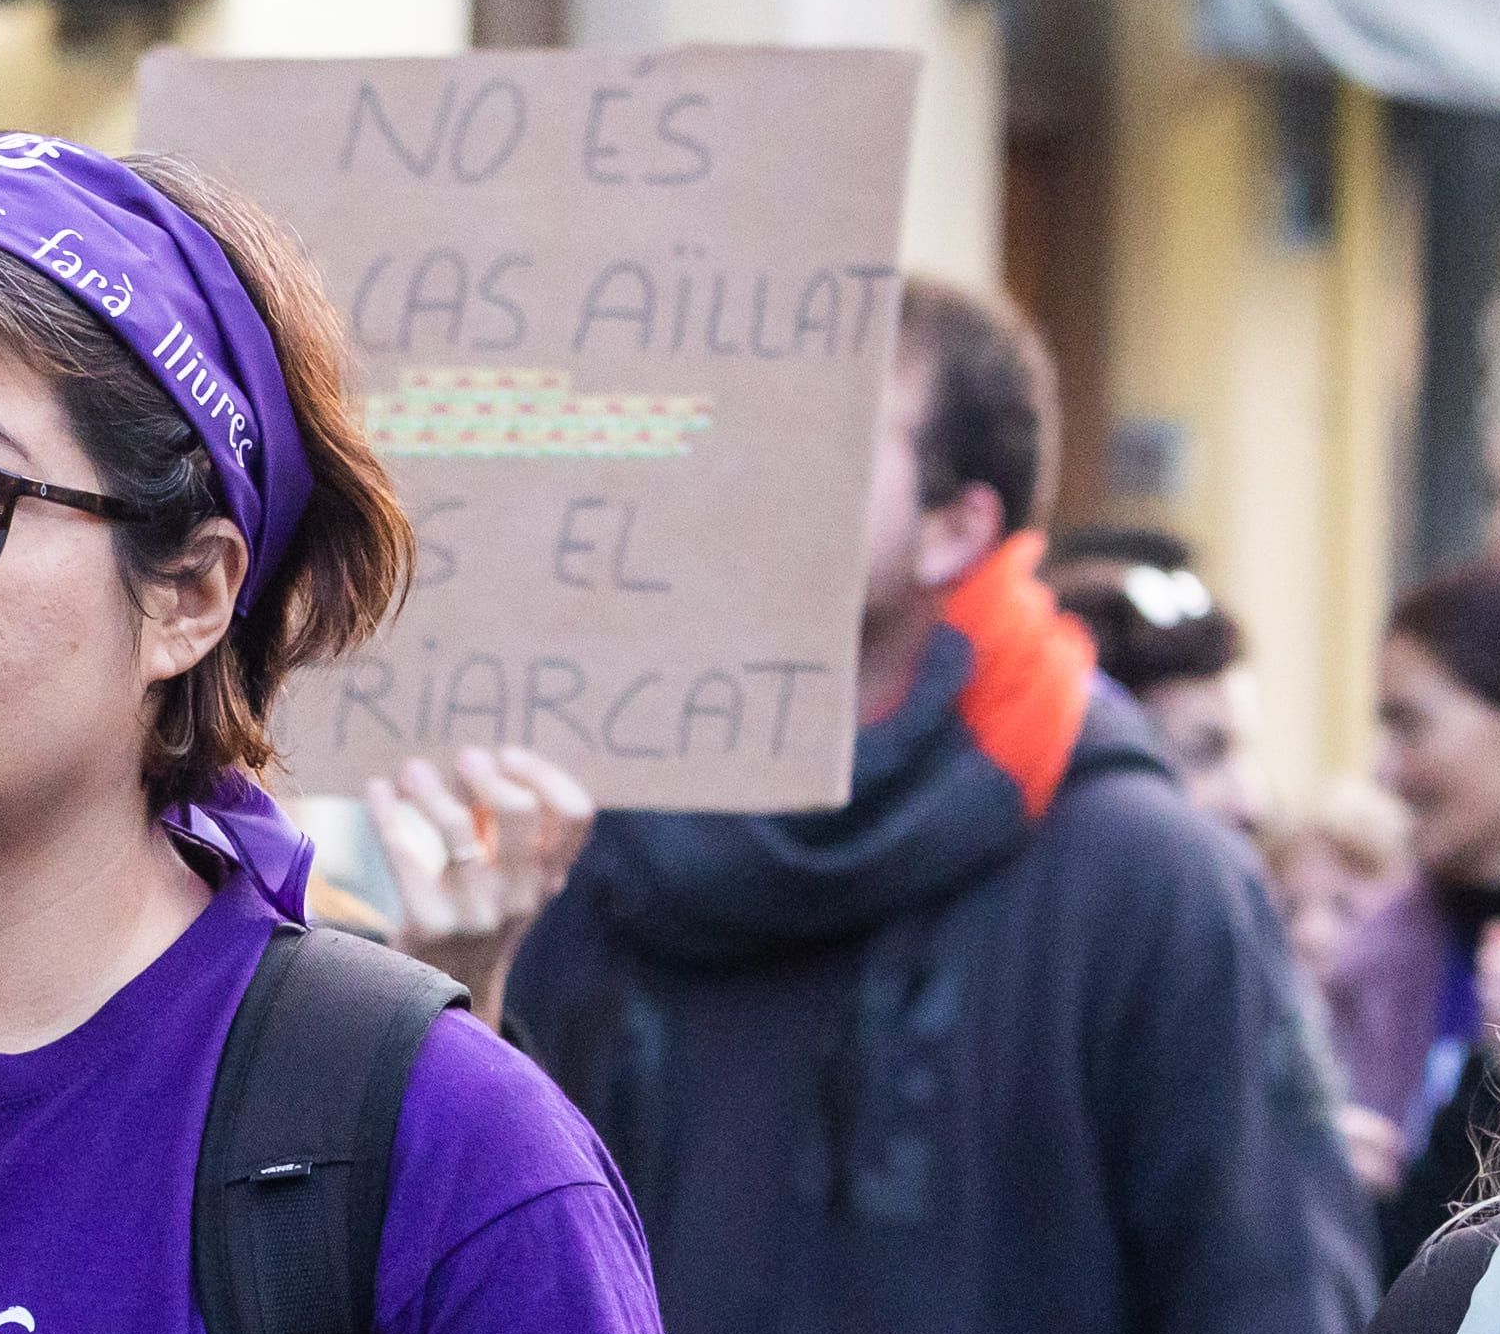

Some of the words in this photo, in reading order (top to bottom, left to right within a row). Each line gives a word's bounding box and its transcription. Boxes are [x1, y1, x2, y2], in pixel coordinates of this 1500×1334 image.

[336, 76, 529, 185] NO
[581, 58, 716, 187] ÉS
[31, 228, 133, 318] farà
[151, 320, 254, 468] lliures
[347, 247, 535, 354] CAS
[570, 244, 900, 361] AÏLLAT
[553, 497, 674, 593] EL
